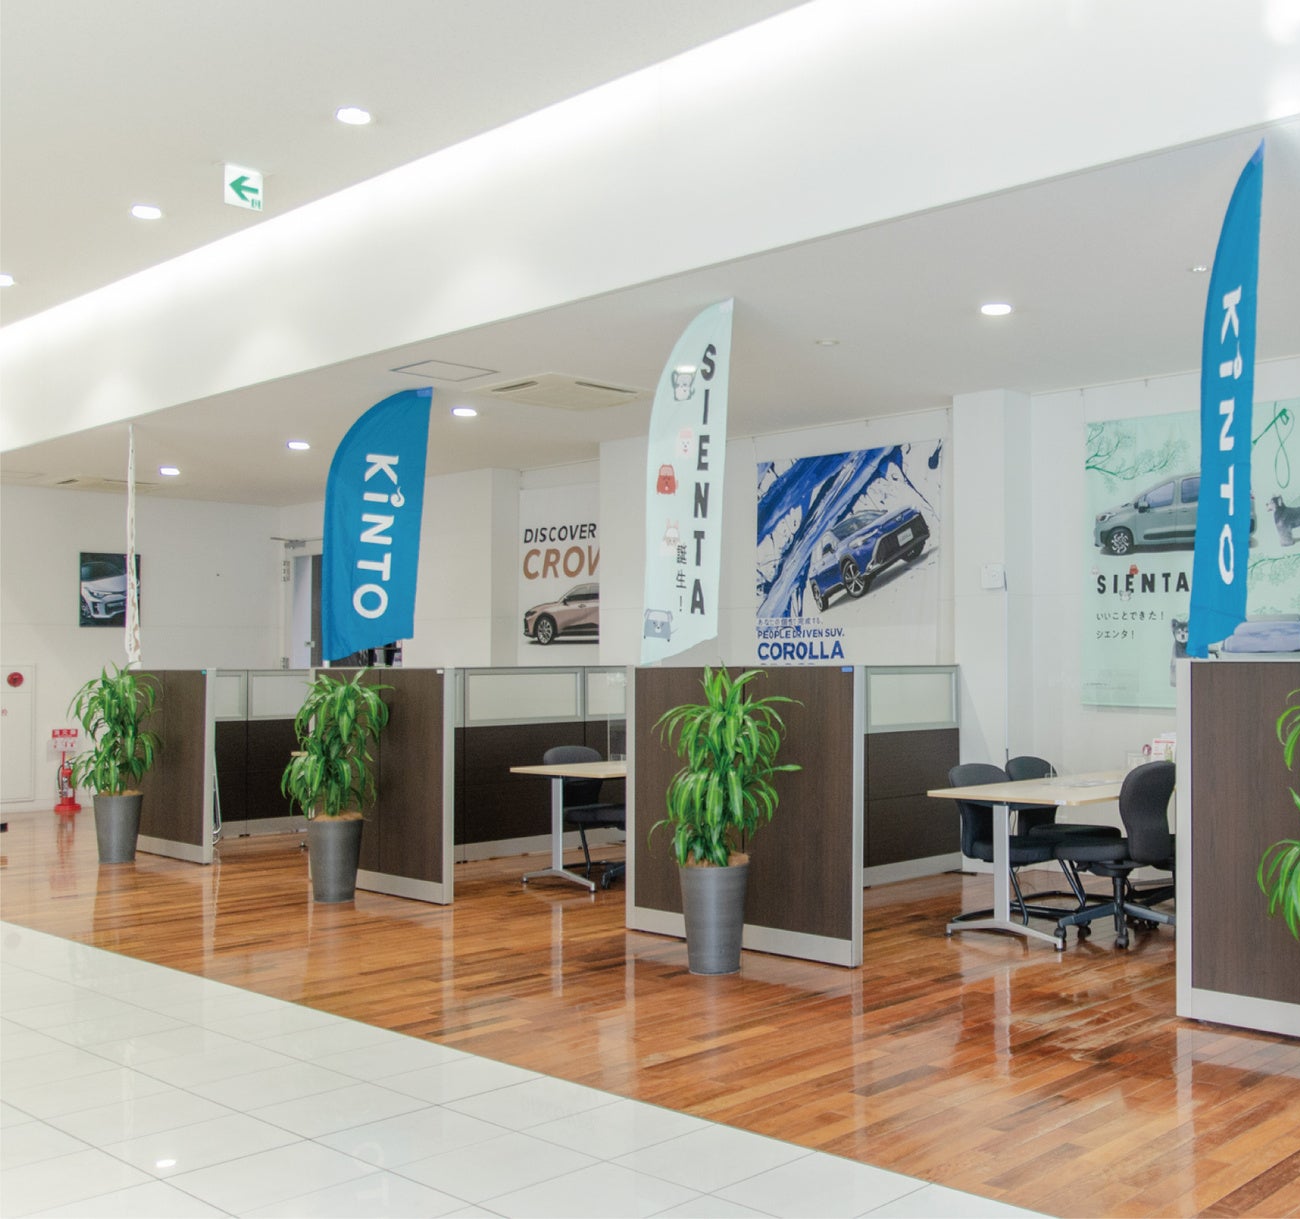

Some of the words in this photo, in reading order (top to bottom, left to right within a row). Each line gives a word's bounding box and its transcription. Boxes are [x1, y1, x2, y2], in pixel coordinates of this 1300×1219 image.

[690, 343, 717, 615] SIENTA
[523, 522, 597, 544] DISCOVER
[1097, 571, 1190, 594] SIENTA
[757, 629, 791, 639] PEOPLE
[792, 628, 823, 638] DRIVEN
[824, 627, 845, 638] SUV.
[757, 640, 845, 660] COROLLA
